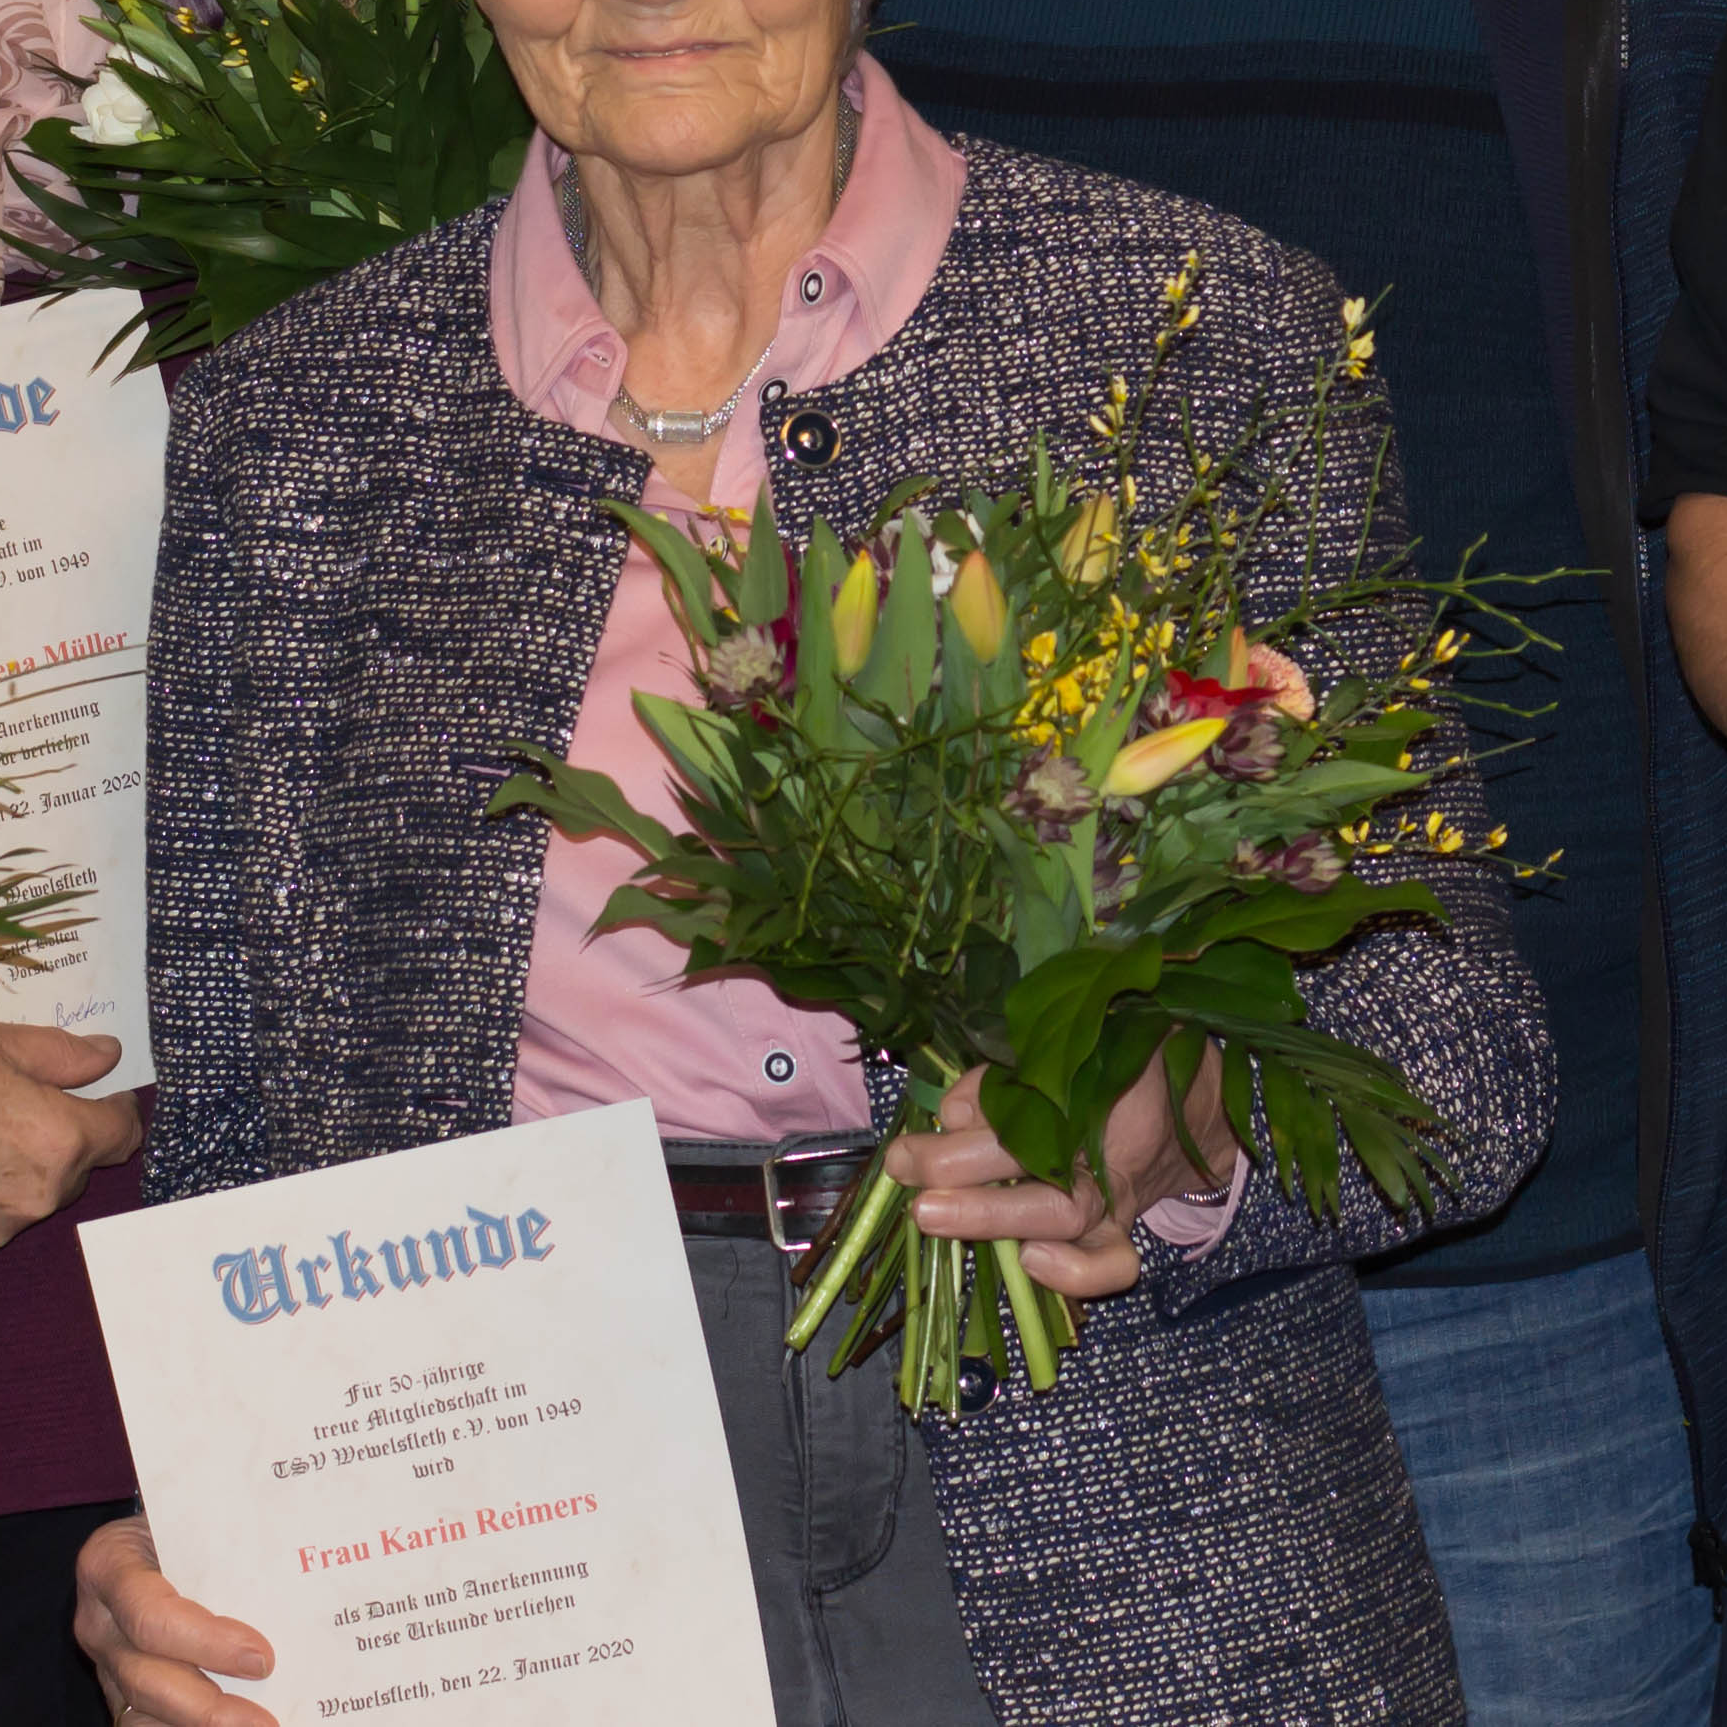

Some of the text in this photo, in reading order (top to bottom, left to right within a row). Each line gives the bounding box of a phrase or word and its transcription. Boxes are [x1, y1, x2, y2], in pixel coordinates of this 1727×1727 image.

[17, 563, 46, 583] von
[50, 551, 90, 575] 1949
[23, 536, 43, 554] im
[43, 629, 129, 666] Müller
[22, 731, 91, 760] verliehen
[10, 801, 35, 818] 22.
[39, 784, 97, 814] Januar
[102, 770, 142, 795] 2020
[212, 1204, 555, 1325] Urkunde
[313, 1381, 528, 1440] treue Mitgliedschaft im
[344, 1382, 383, 1407] Für
[270, 1398, 582, 1479] TSV Wewelsfleth e.V. von 1949
[411, 1457, 455, 1479] wird
[297, 1492, 599, 1574] Frau Karin Reimers
[333, 1560, 590, 1627] als Dank und Anerkennung
[355, 1592, 576, 1652] diese Urkunde verliehen
[317, 1638, 635, 1719] Wewelsfleth, den 22. Januar 2020
